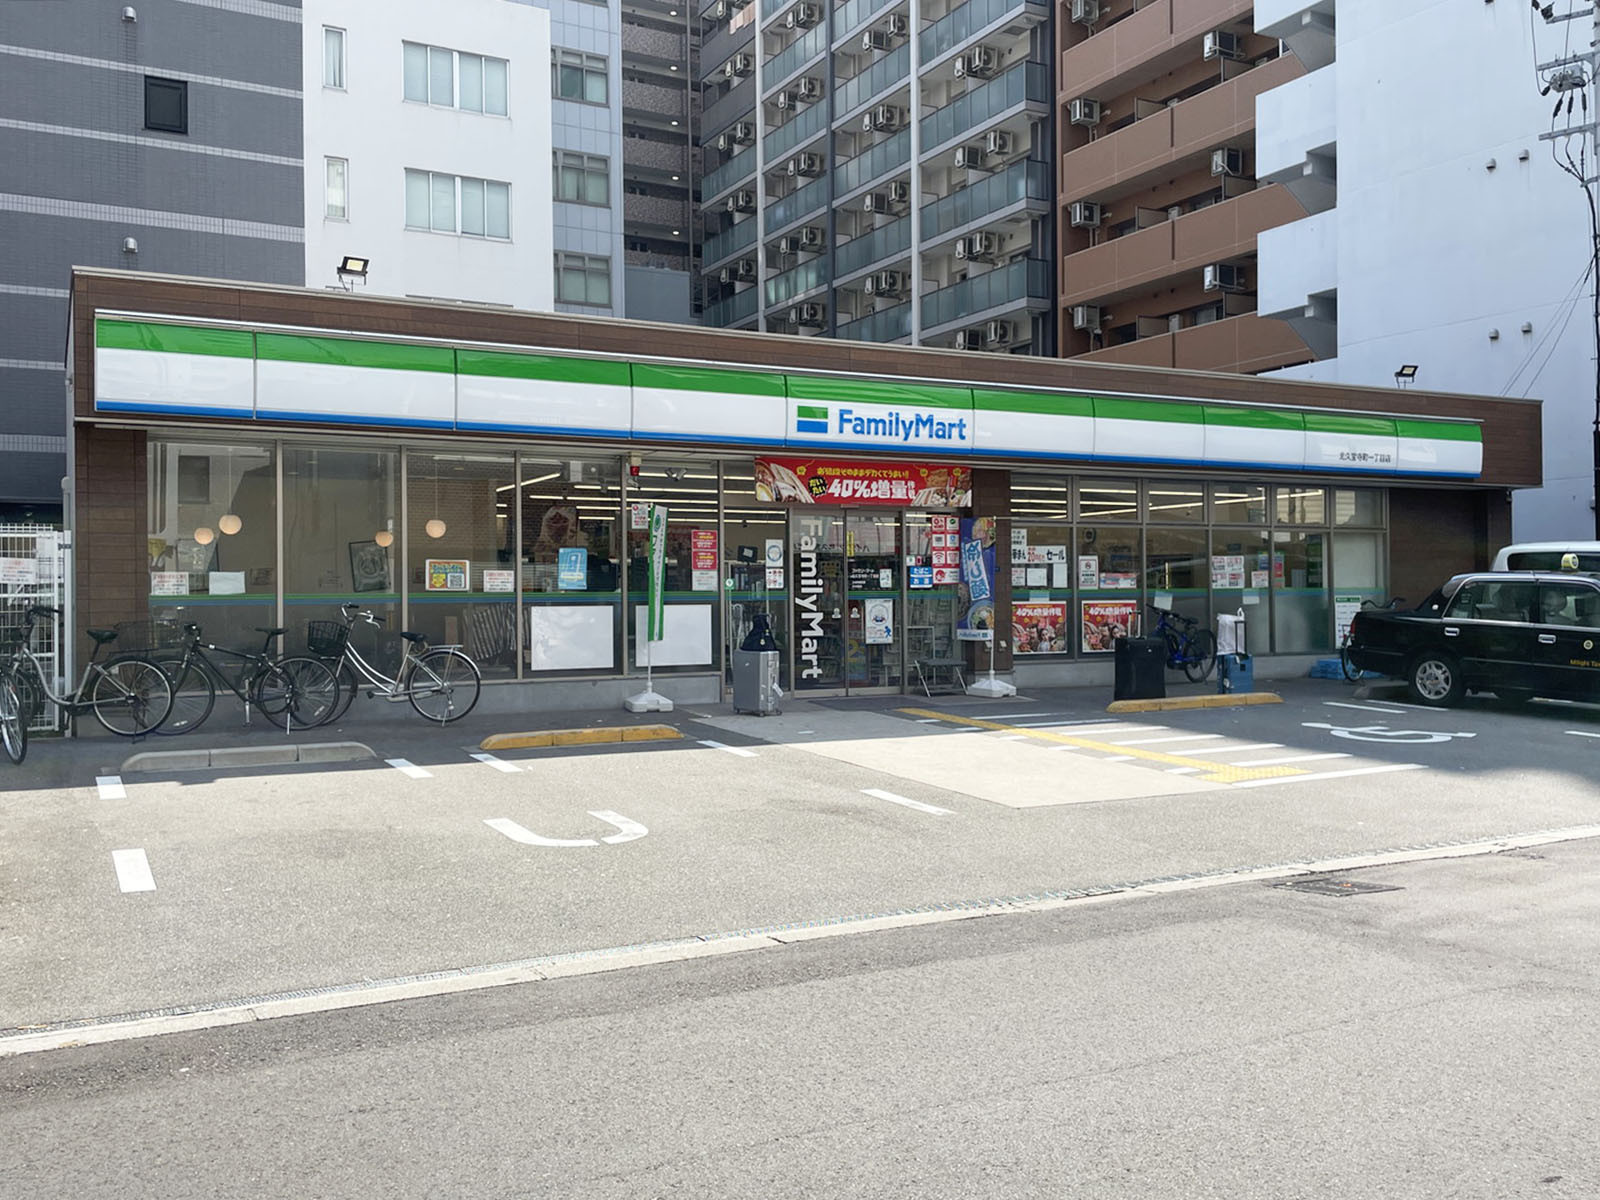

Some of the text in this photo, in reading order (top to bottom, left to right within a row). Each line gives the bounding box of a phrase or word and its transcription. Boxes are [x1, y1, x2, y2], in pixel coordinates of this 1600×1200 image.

[839, 408, 967, 441] FamilyMart
[1046, 548, 1065, 561] セール
[913, 567, 929, 575] たばこ
[795, 519, 825, 680] FamilyMart
